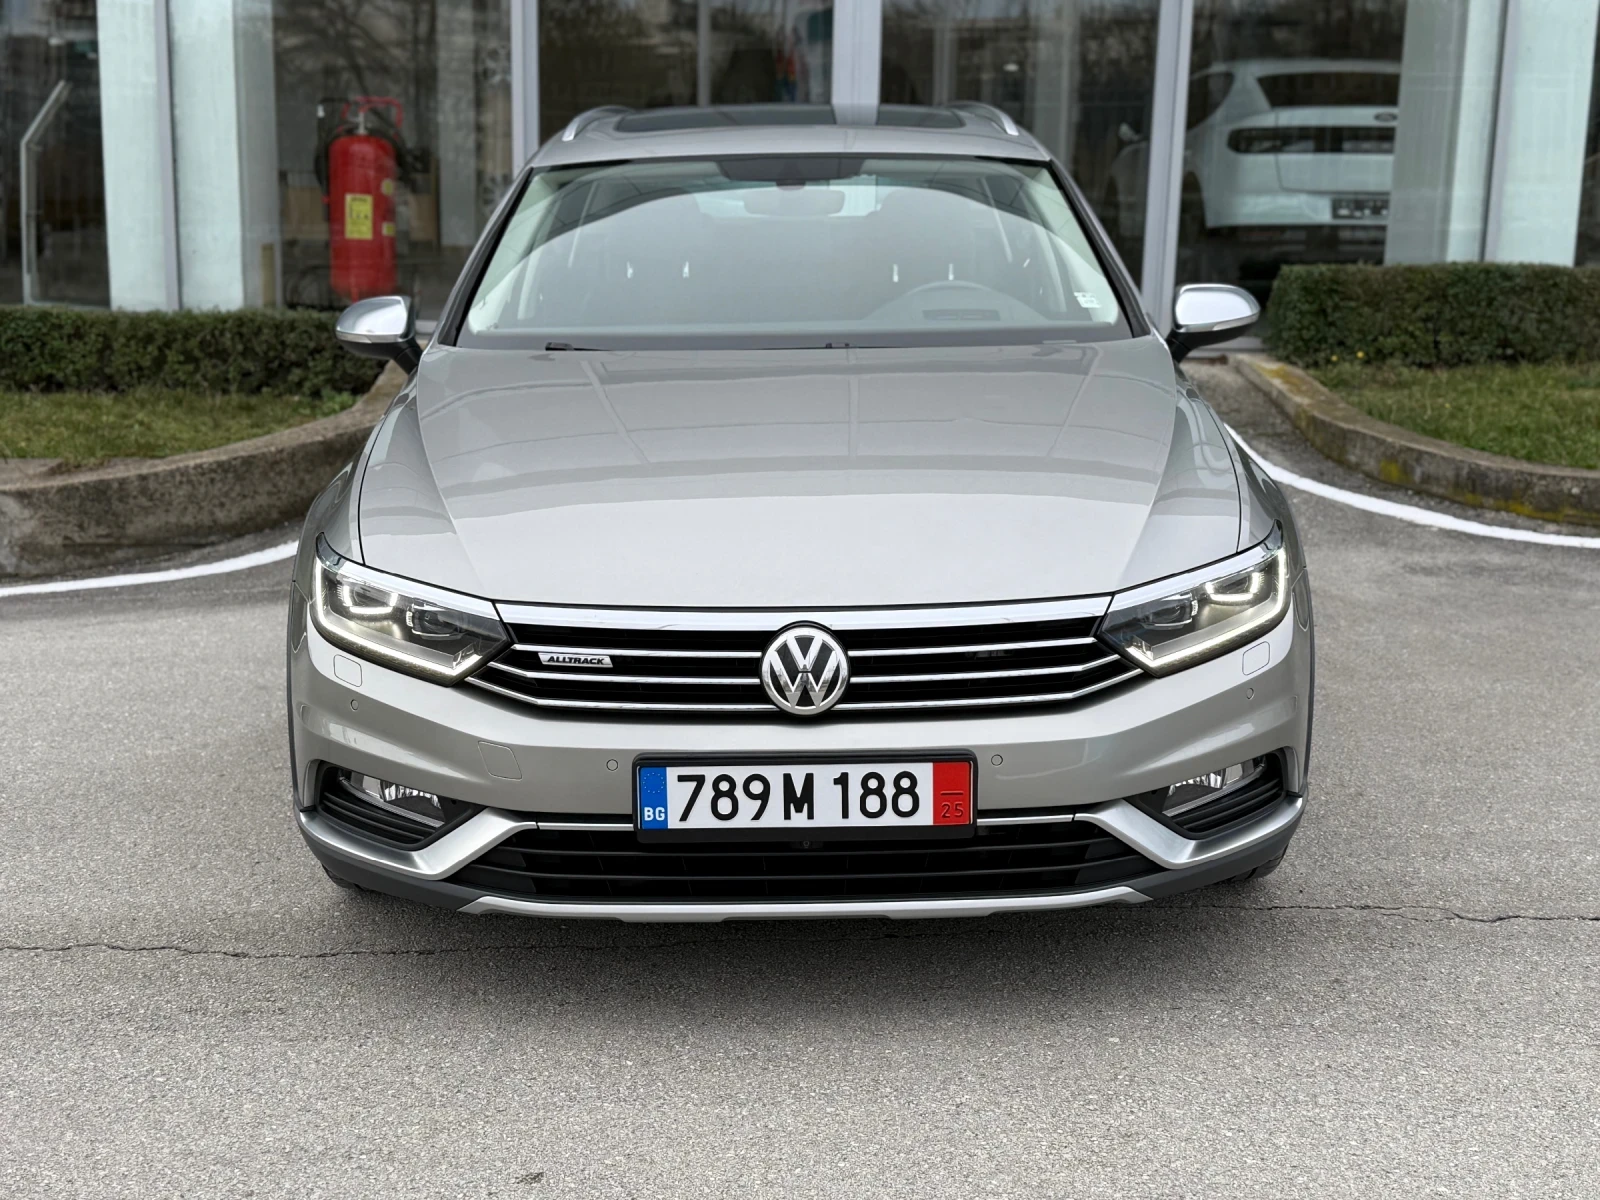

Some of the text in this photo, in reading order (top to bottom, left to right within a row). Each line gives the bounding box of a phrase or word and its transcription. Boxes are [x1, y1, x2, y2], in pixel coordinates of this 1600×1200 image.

[547, 655, 605, 665] ALLTRACK
[764, 628, 846, 712] VW
[643, 806, 666, 821] BG
[940, 801, 964, 819] 25
